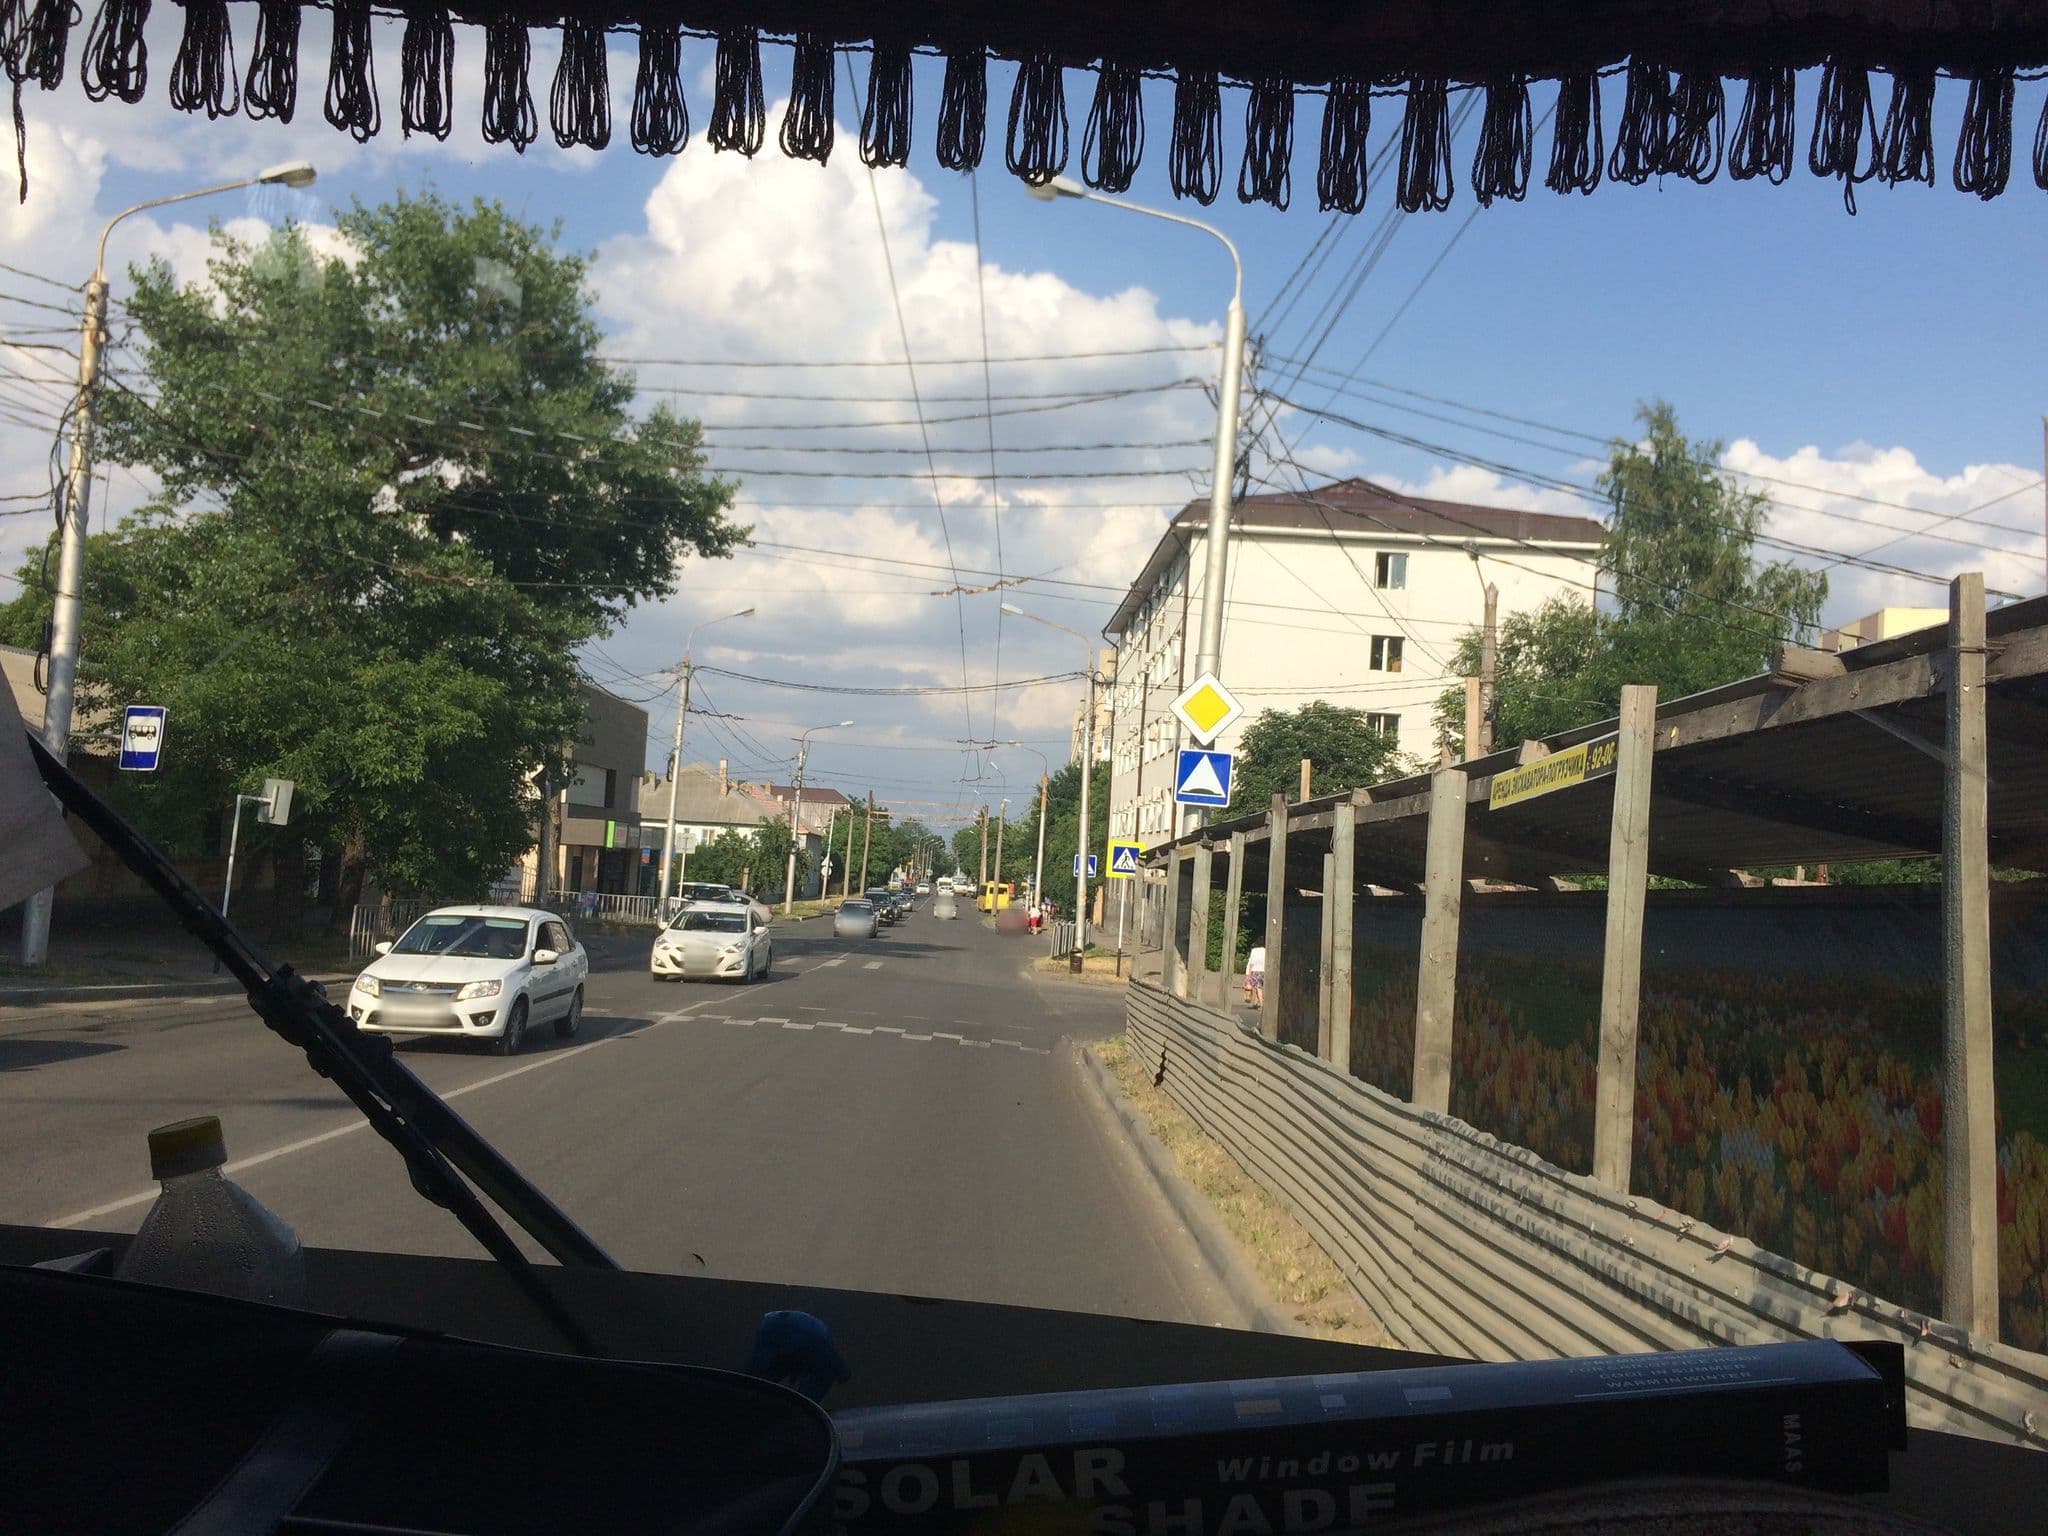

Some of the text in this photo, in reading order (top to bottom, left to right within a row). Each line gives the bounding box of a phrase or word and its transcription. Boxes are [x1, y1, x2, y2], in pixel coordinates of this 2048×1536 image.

[832, 1447, 1135, 1521] SOLAR
[1218, 1439, 1515, 1482] Window Film
[1087, 1482, 1396, 1536] SHADE
